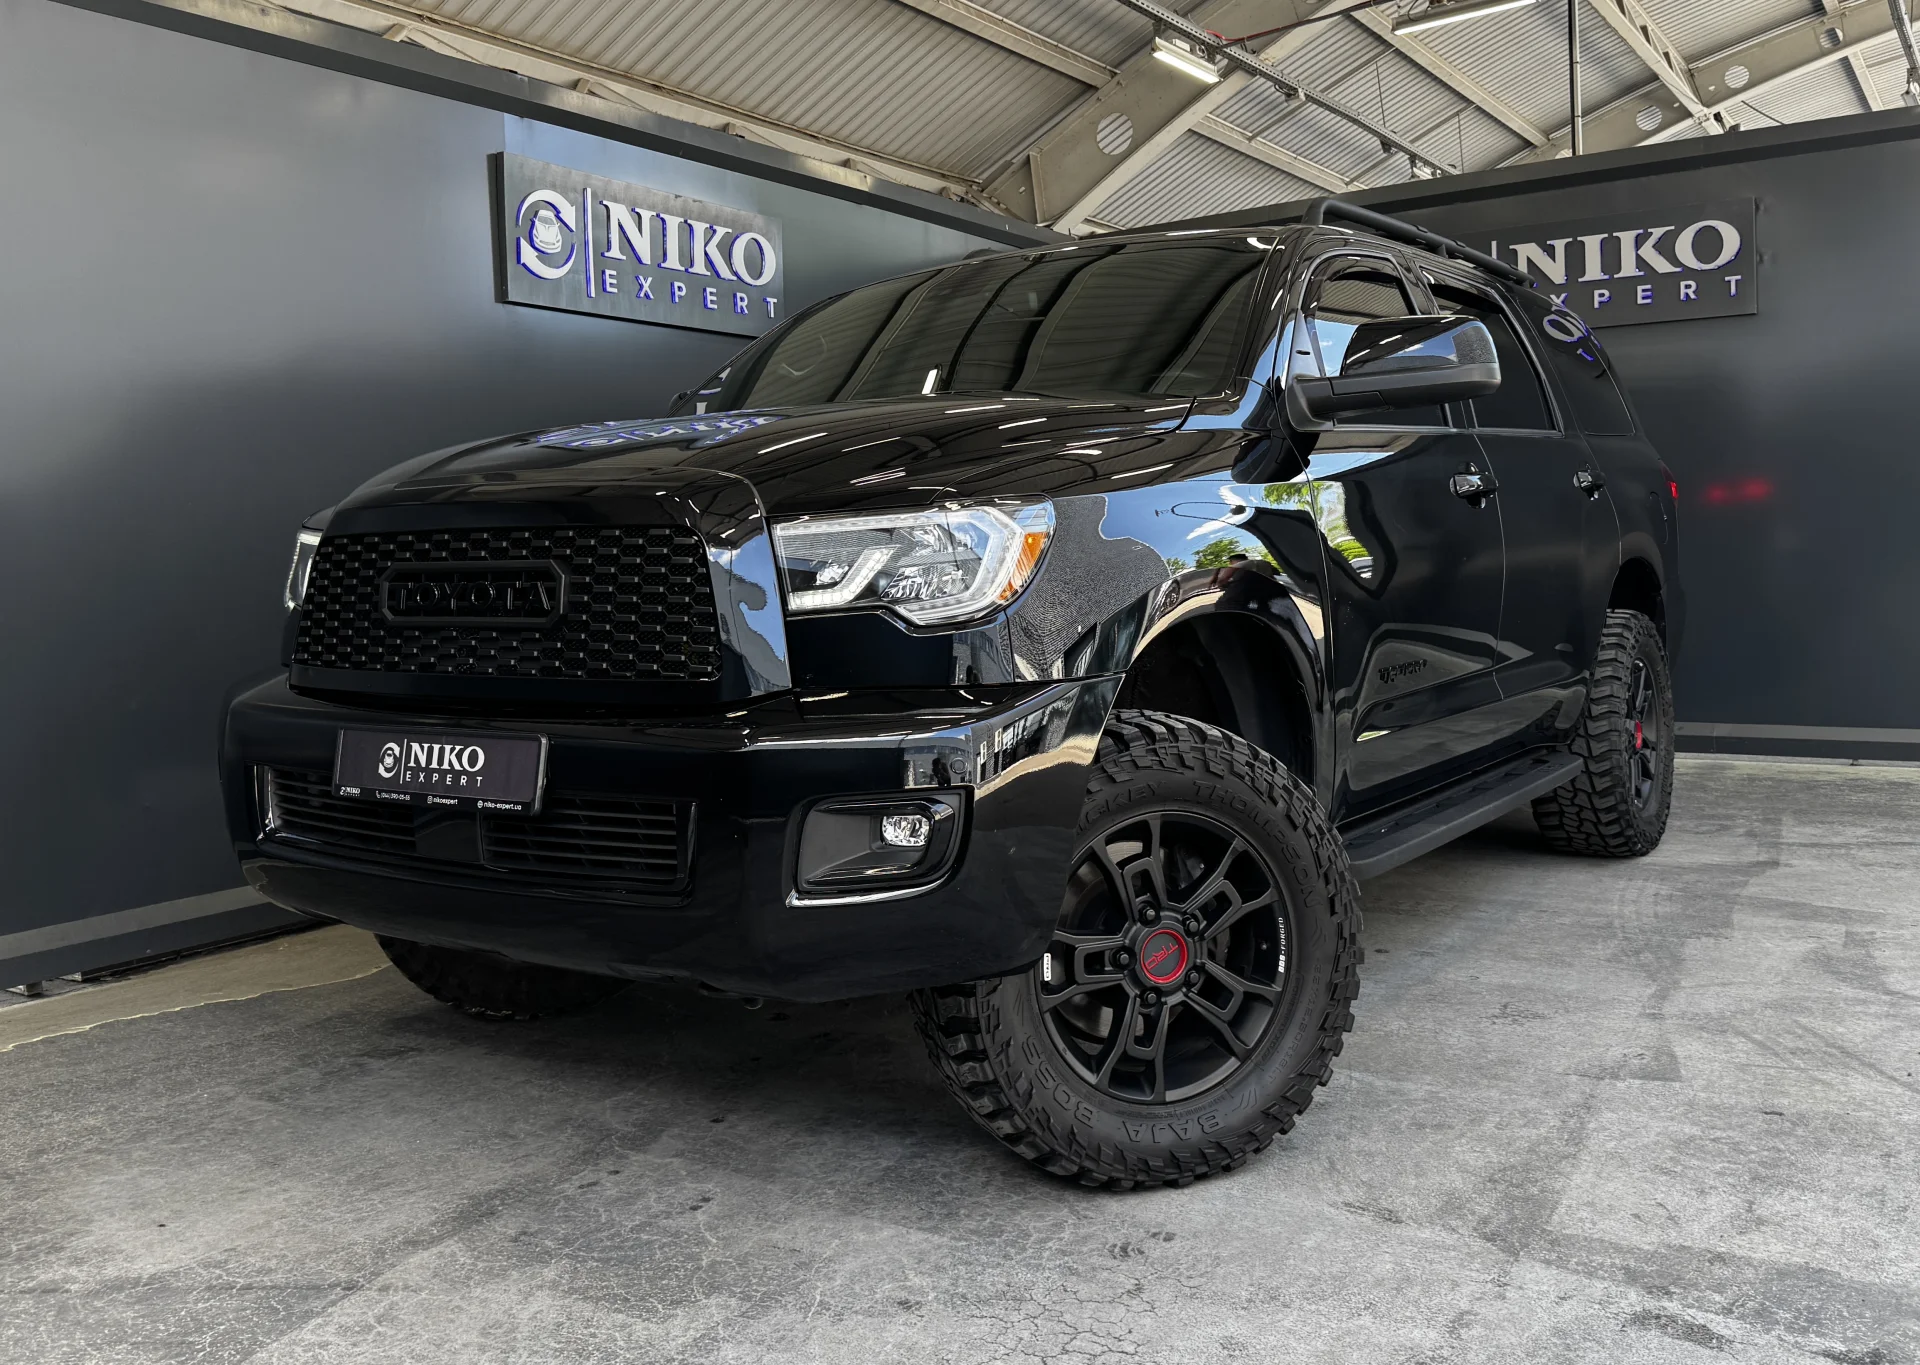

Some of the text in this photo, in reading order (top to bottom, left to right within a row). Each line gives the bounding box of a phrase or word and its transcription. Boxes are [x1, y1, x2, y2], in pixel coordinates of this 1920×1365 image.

[599, 200, 777, 286] NIKO
[1508, 219, 1742, 285] NIKO
[602, 269, 778, 318] EXPERT
[1549, 275, 1742, 309] XPERT
[391, 581, 551, 611] TOYOTA
[407, 742, 486, 772] NIKO
[405, 771, 483, 787] EXPERT
[433, 797, 458, 805] nikoexpert
[483, 801, 522, 811] niko-expert.ua
[1277, 917, 1286, 950] FORGED
[1145, 942, 1179, 970] TRD
[1022, 1035, 1098, 1129] BOSS
[1122, 1110, 1226, 1143] BAJA
